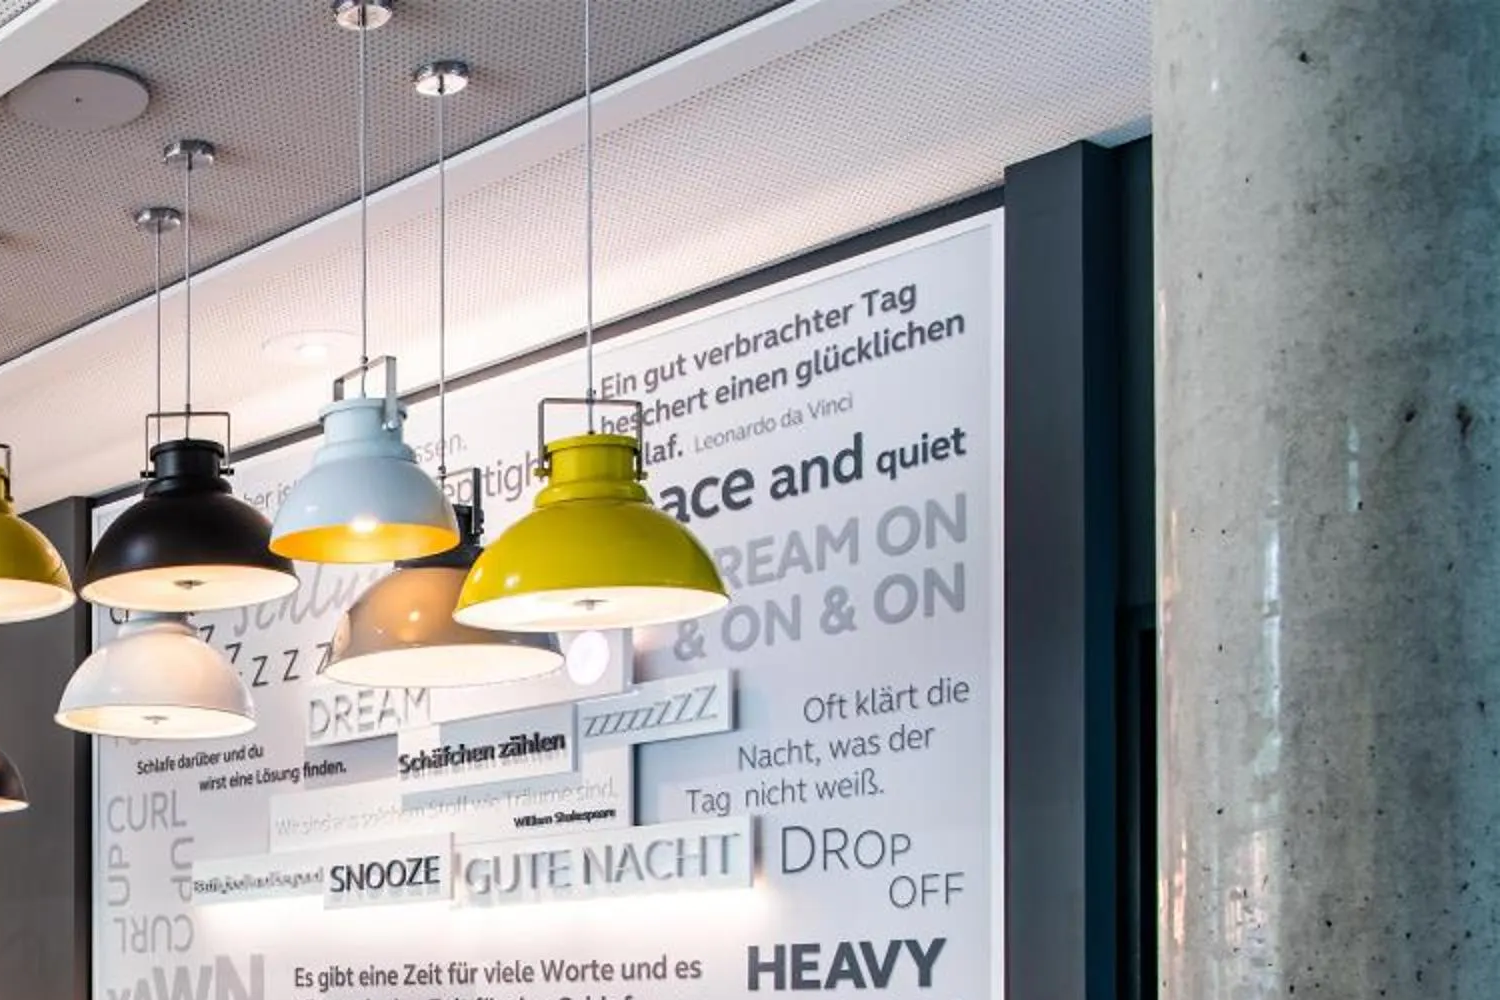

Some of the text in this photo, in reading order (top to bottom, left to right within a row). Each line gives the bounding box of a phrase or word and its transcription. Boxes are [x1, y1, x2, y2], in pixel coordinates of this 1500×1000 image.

[601, 281, 918, 401] Ein gut verbrachter Tag
[715, 365, 787, 405] einen
[795, 311, 966, 387] glücklichen
[644, 391, 854, 467] laf. Leonardo da Vinci
[485, 450, 543, 503] tigh
[660, 426, 968, 525] ace and quiet
[714, 492, 968, 590] REAM ON
[721, 595, 801, 653] ON
[819, 584, 858, 636] &
[873, 562, 967, 626] ON
[309, 688, 431, 741] DREAM
[803, 677, 971, 723] Oft klärt die
[136, 744, 264, 776] Schlafe darüber und du
[398, 731, 566, 775] Schäfchen zählen
[738, 724, 936, 771] Nacht, was der
[199, 759, 348, 792] wirst eine Lösung finden.
[686, 767, 885, 817] Tag nicht weiß.
[107, 789, 187, 834] CURL
[108, 843, 131, 907] UP
[170, 836, 195, 904] UP
[329, 854, 440, 893] SNOOZE
[464, 832, 742, 895] GUTE NACHT
[781, 825, 912, 874] DROP
[889, 872, 965, 908] OFF
[113, 914, 195, 954] CURL
[294, 953, 702, 993] Es gibt eine Zeit für viele Worte und es
[747, 937, 948, 991] HEAVY
